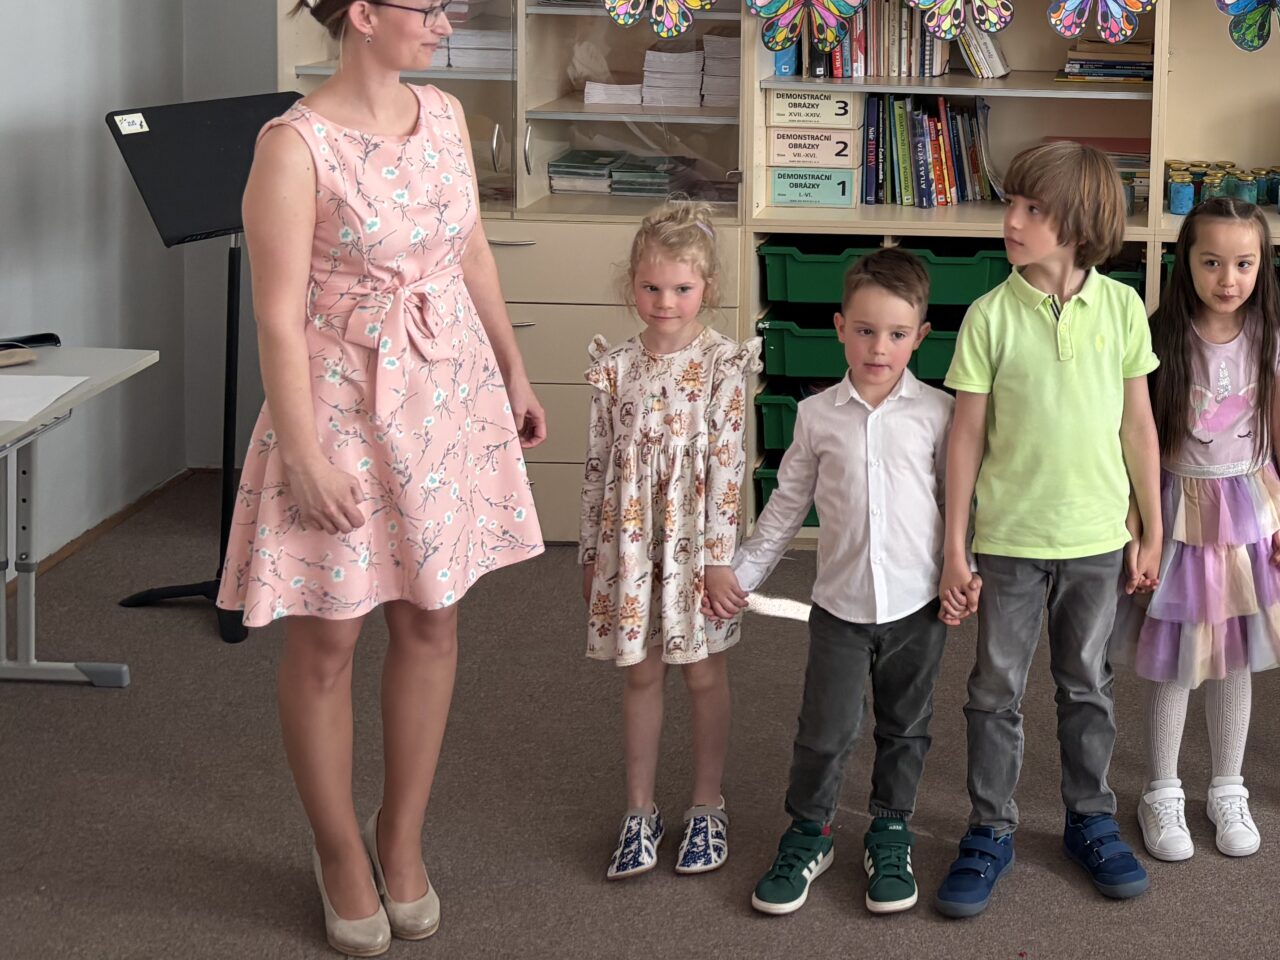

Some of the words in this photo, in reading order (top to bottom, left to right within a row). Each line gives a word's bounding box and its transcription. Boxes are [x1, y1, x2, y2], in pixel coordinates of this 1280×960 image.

[776, 92, 832, 101] DEMONSTRAČNÍ
[834, 100, 849, 116] 3
[776, 133, 832, 142] DEMONSTRAČNÍ
[788, 142, 820, 150] OBRÁZKY
[834, 140, 849, 157] 2
[777, 173, 832, 181] DEMONSTRAČNÍ
[836, 180, 847, 197] 1
